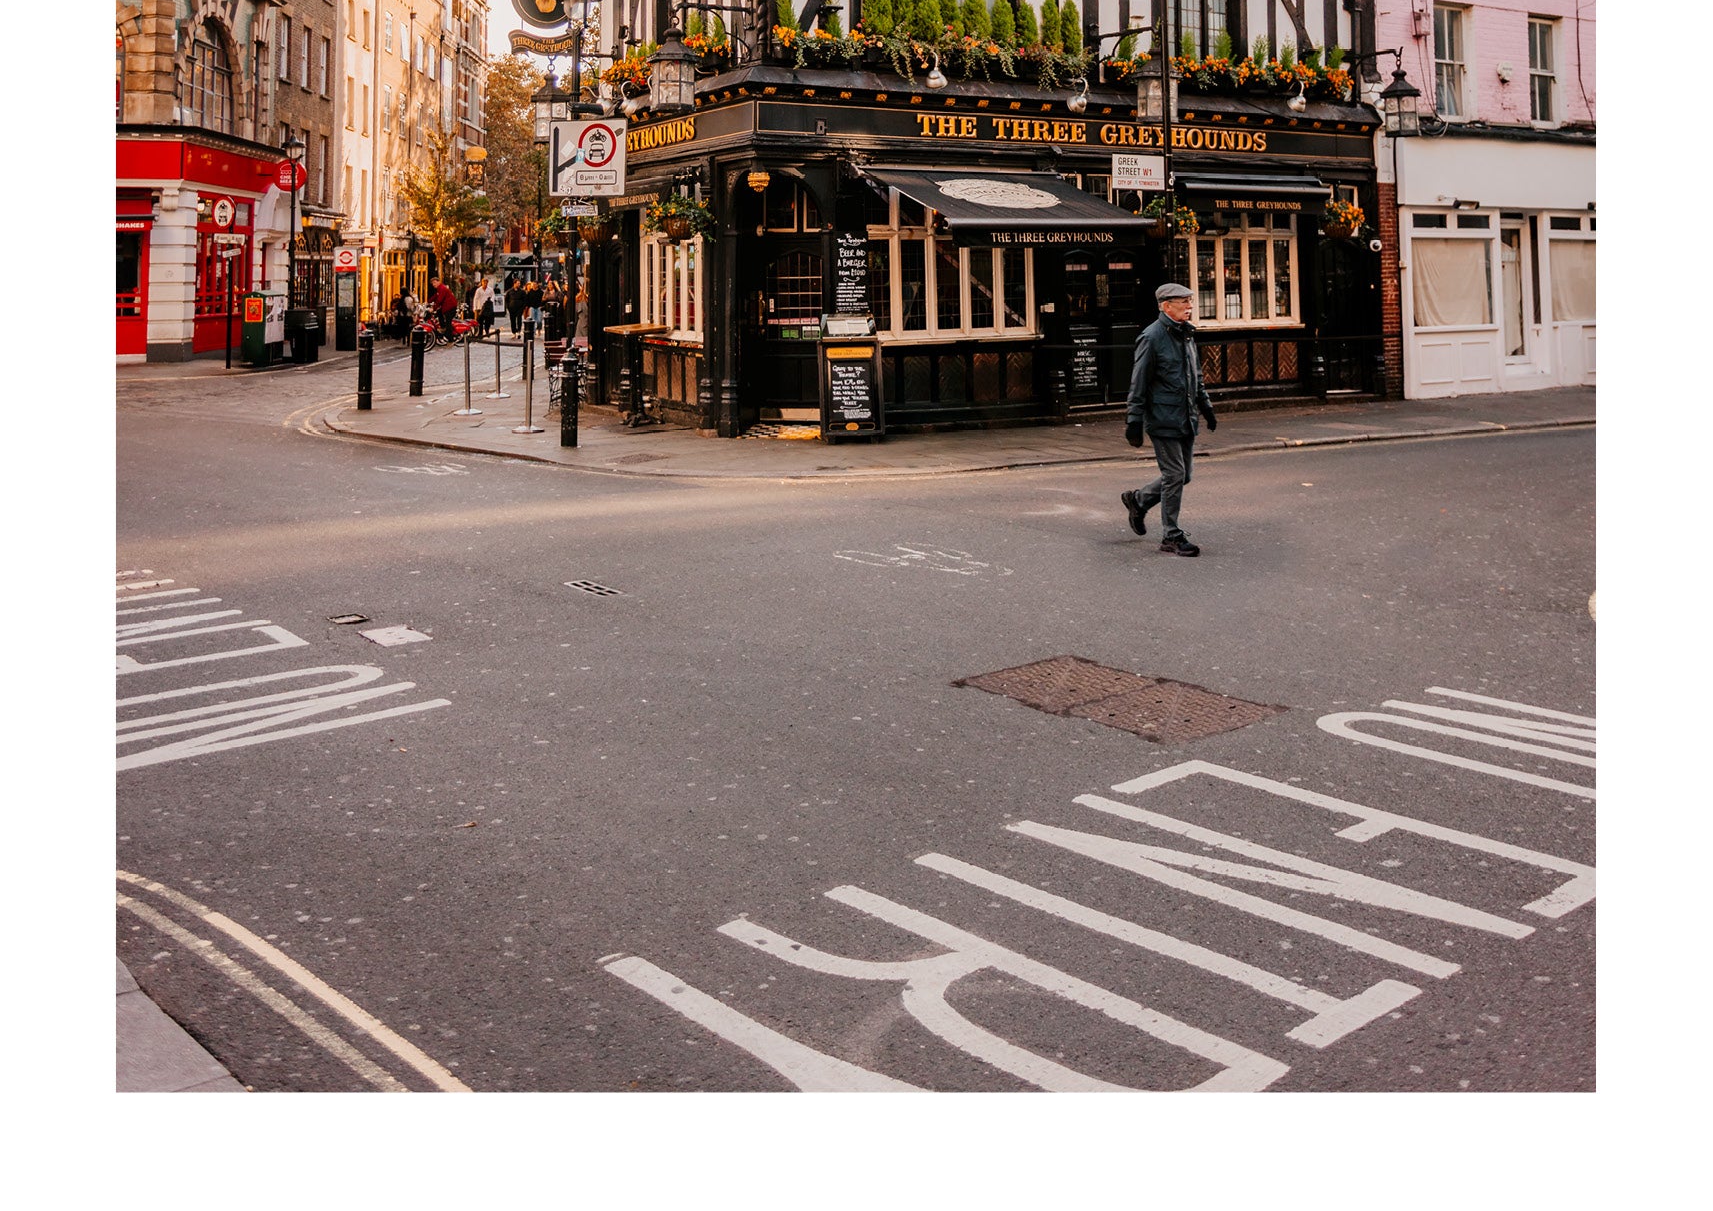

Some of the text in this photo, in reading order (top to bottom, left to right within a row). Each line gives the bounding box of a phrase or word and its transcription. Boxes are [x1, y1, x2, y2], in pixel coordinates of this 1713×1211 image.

[512, 37, 535, 51] THREE
[627, 117, 695, 152] EYHOUNDS
[916, 113, 1267, 152] THE THREE GREYHOUNDS
[1118, 157, 1138, 166] GREEK
[1118, 167, 1152, 176] STREET W1
[1215, 200, 1302, 210] THE THREE GREYHOUNDS
[991, 232, 1114, 243] THE THREE GREYHOUNDS
